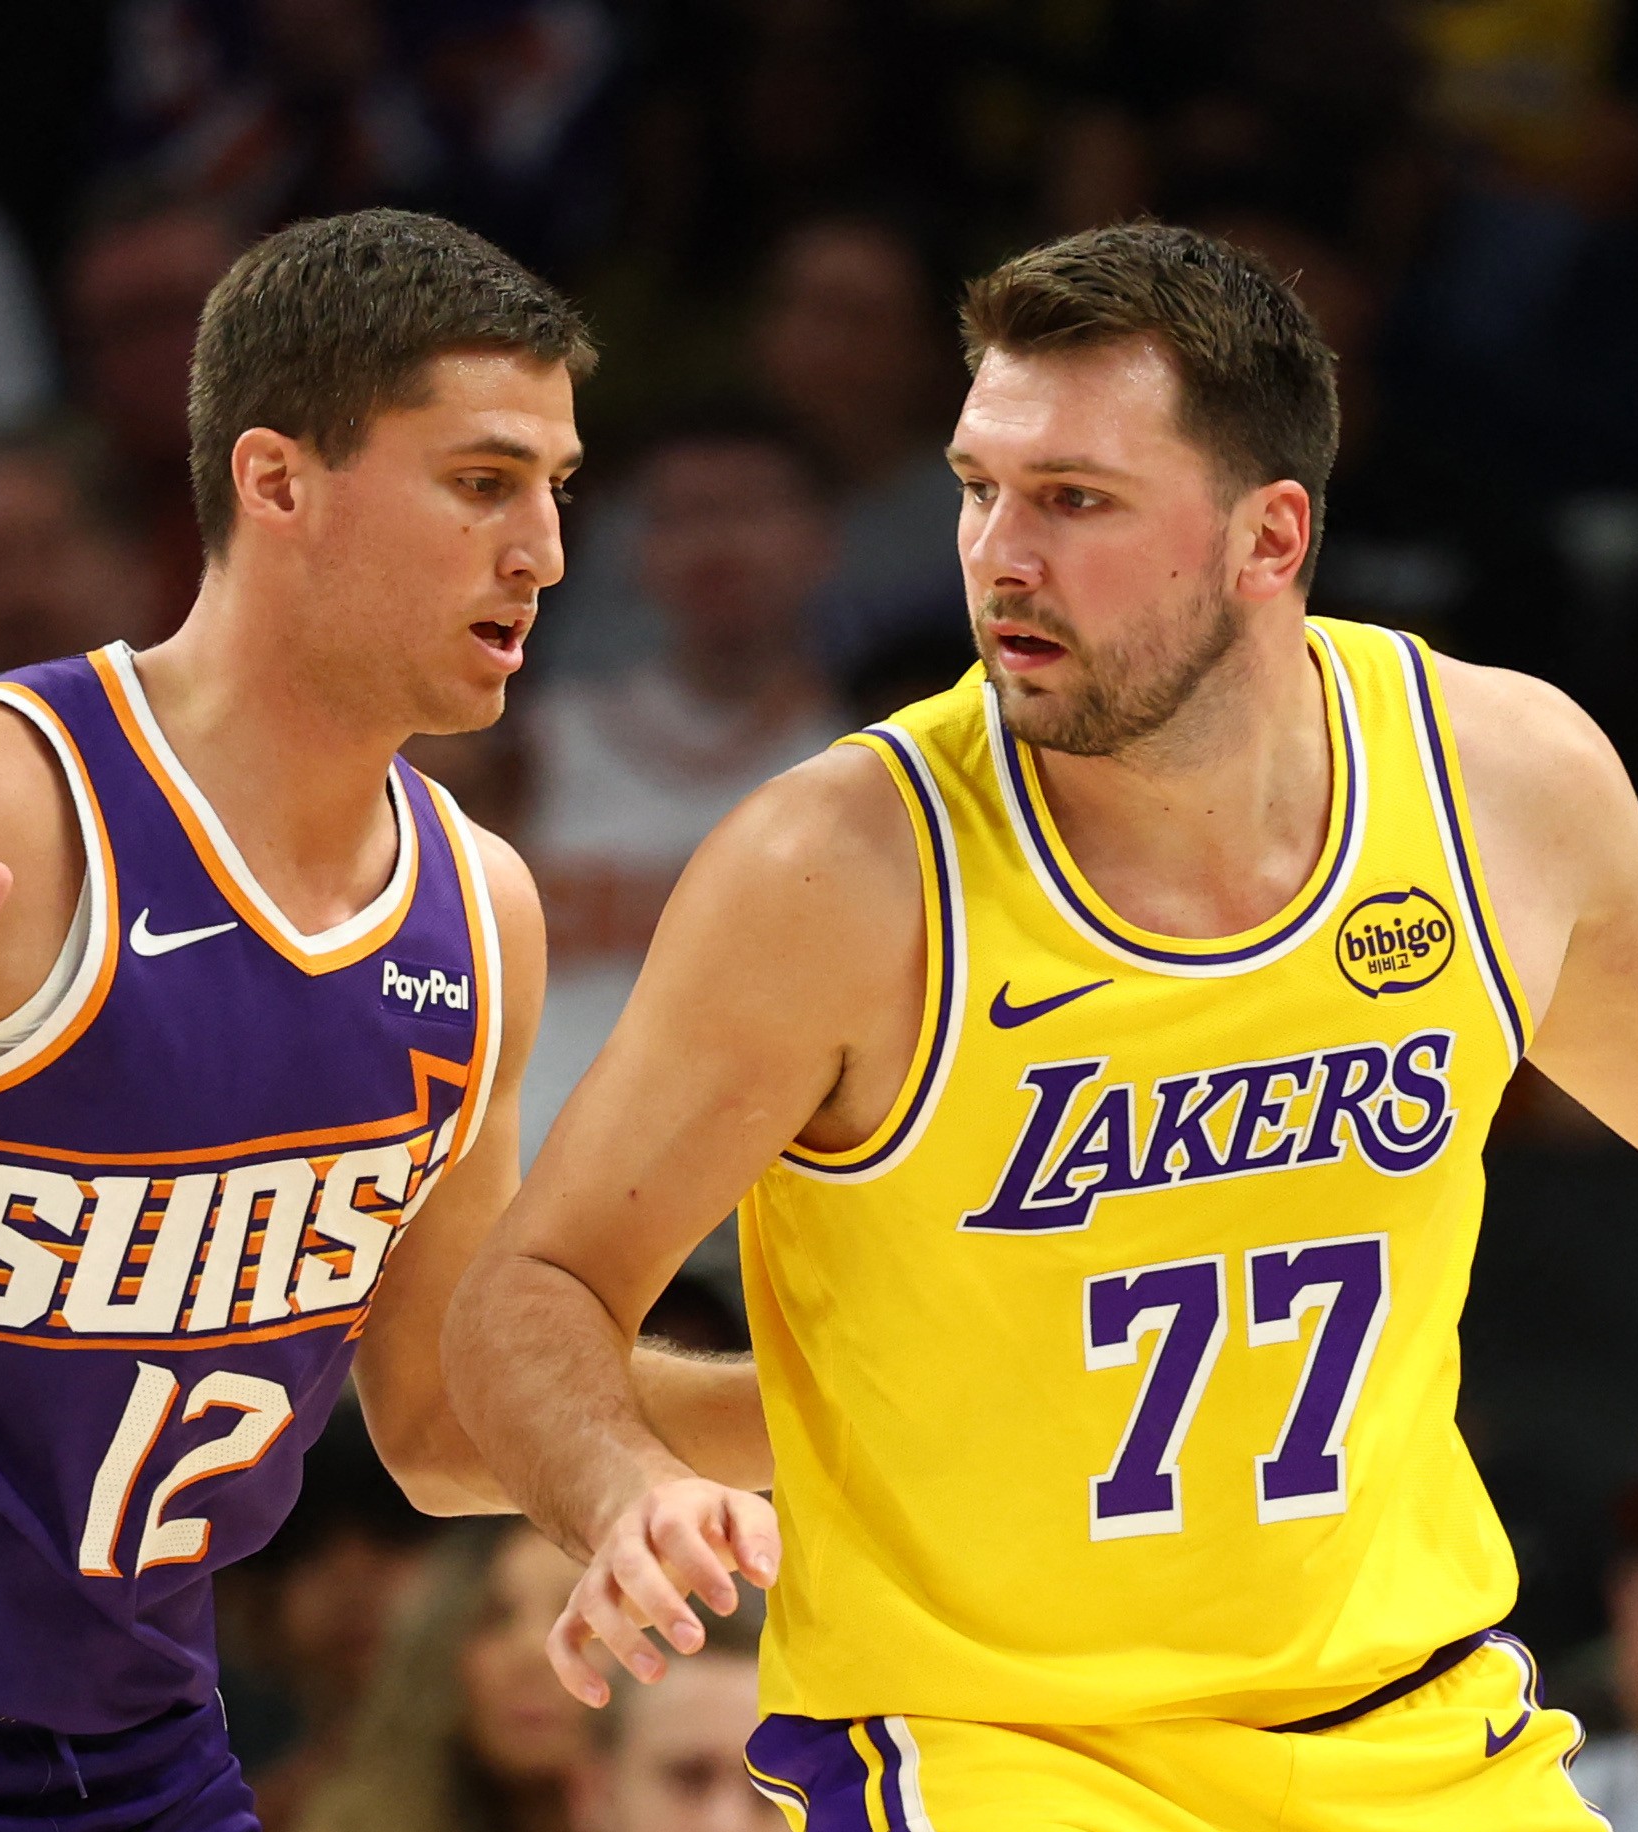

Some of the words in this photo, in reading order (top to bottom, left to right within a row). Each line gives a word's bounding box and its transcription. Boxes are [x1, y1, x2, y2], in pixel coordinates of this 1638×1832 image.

[381, 960, 469, 1013] PayPal
[1345, 918, 1446, 962] bibigo
[1367, 953, 1411, 975] 비비고
[955, 1027, 1459, 1235] LAKERS
[1082, 1231, 1392, 1542] 77
[78, 1360, 295, 1579] 12
